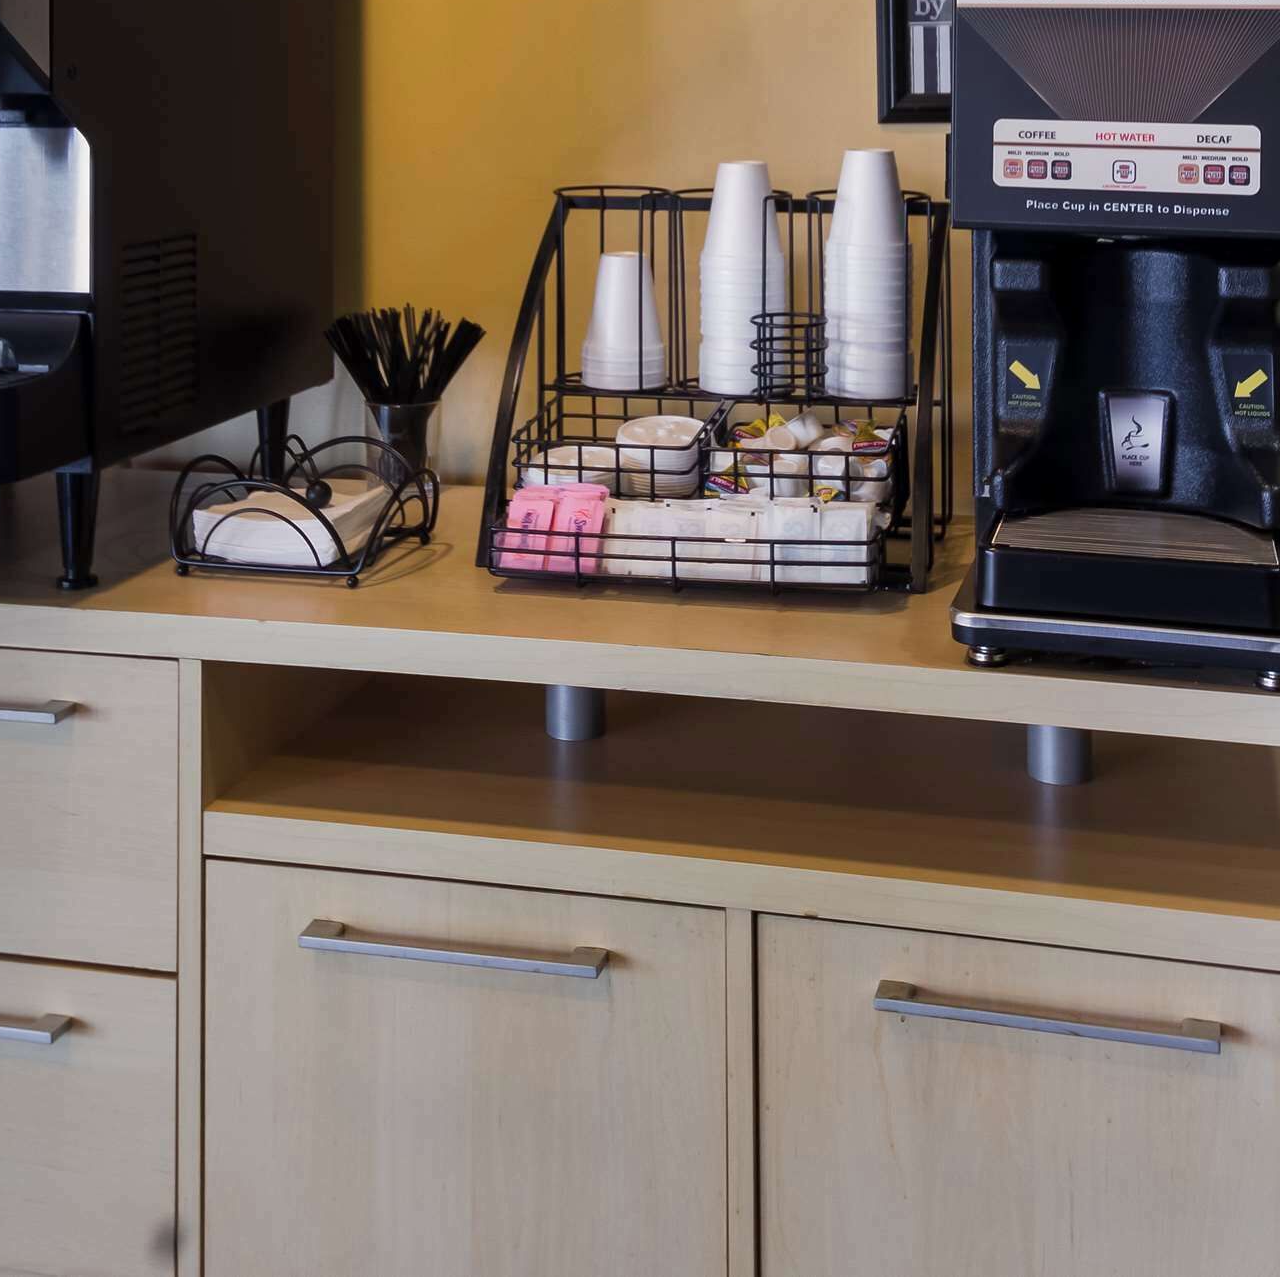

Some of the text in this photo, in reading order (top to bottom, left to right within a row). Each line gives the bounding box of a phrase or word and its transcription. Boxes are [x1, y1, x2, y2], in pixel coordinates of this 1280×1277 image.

[1018, 130, 1233, 144] COFFEE HOT WATER DECAF
[1026, 200, 1230, 216] Place Cup in CENTER to Dispense
